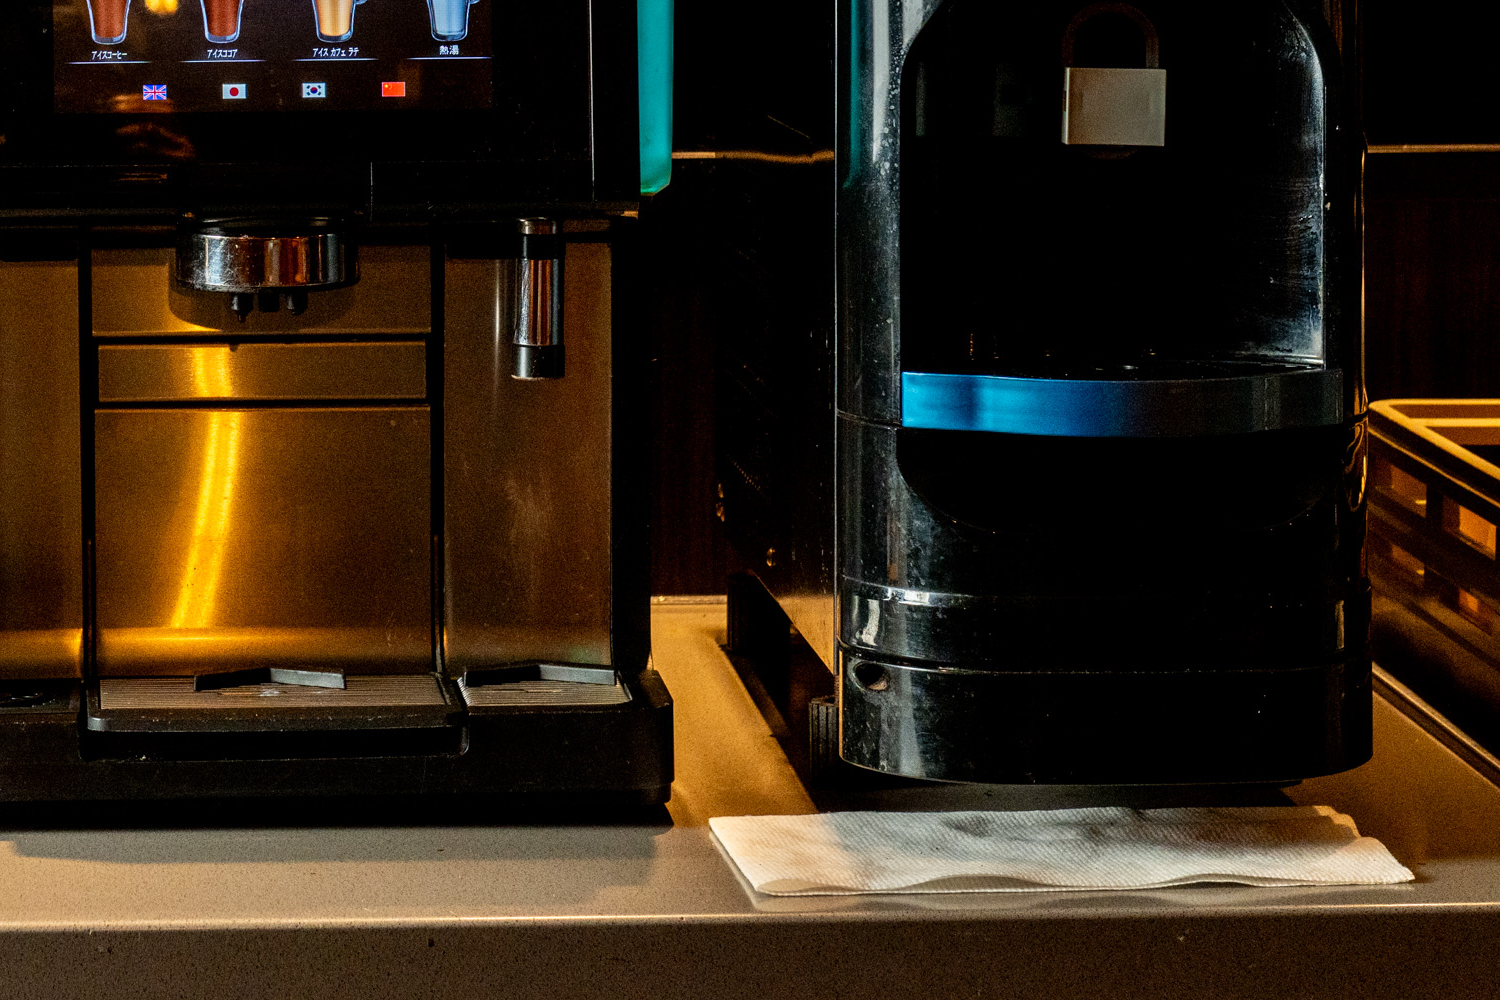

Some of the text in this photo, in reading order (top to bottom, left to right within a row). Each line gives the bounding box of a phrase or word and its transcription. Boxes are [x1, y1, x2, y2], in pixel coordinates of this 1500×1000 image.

[91, 50, 128, 60] アイスコーヒー
[206, 49, 239, 59] アイスココア
[438, 45, 460, 55] 熱湯
